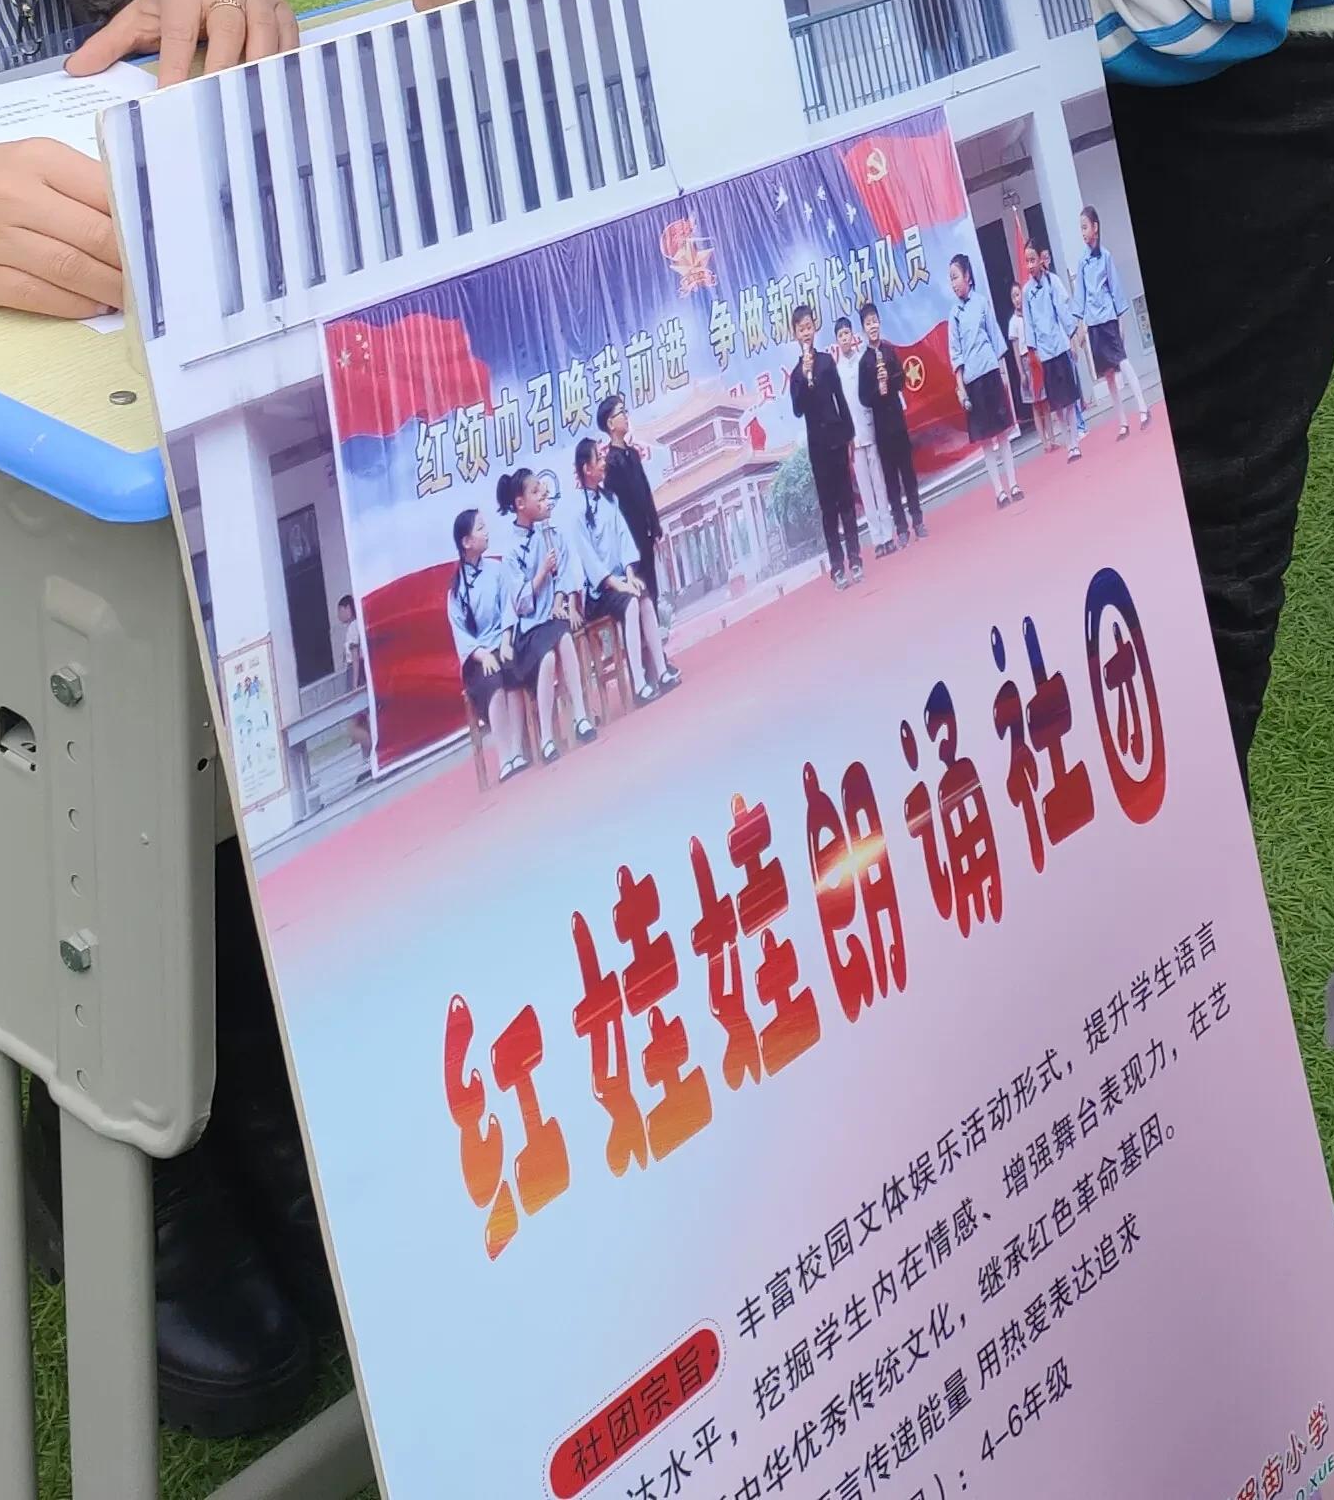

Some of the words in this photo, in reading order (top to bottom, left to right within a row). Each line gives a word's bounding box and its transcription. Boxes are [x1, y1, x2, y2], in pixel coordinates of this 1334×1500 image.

[415, 318, 690, 498] 红领巾召唤我前进
[708, 223, 932, 371] 争做新时代好队员
[443, 566, 1168, 1262] 红娃娃朗诵社团
[722, 1112, 1176, 1500] 中华优秀传统文化，继承红色革命基因。
